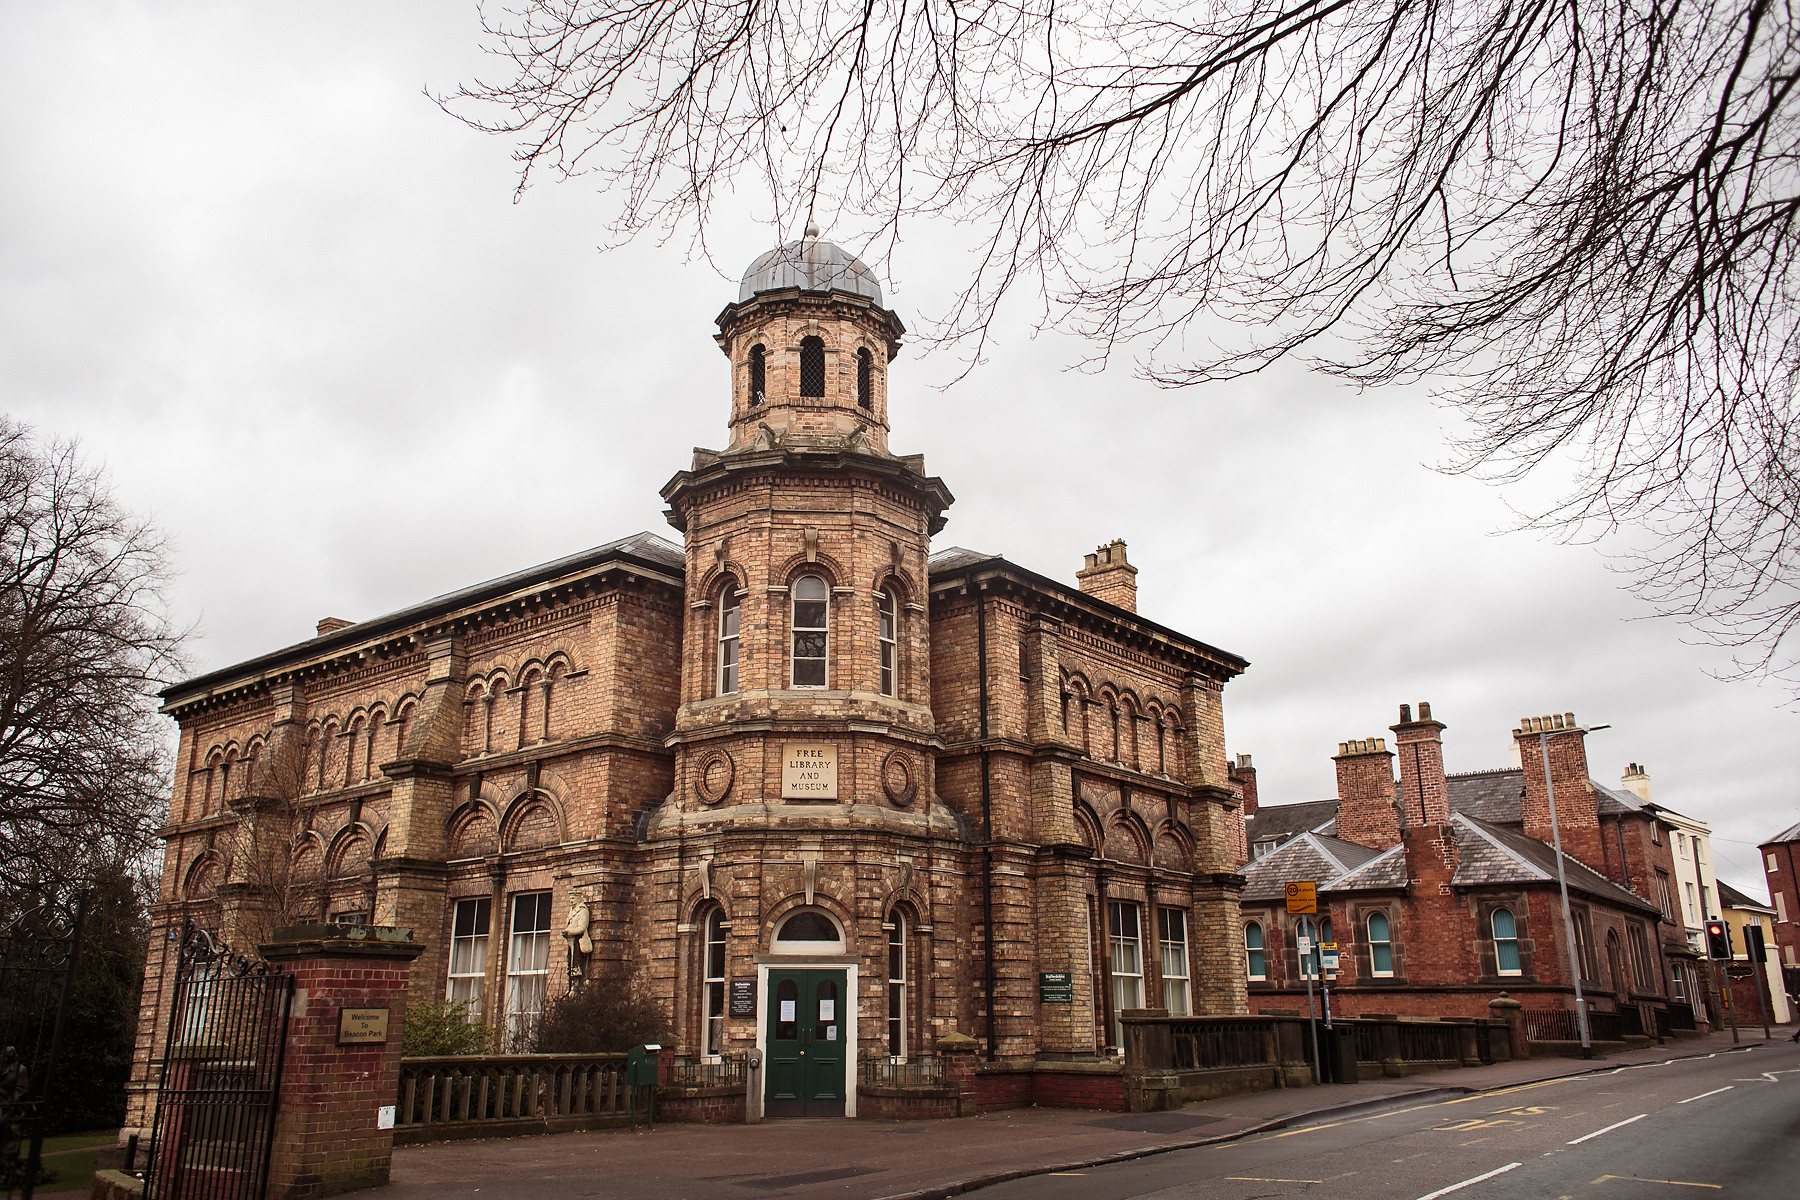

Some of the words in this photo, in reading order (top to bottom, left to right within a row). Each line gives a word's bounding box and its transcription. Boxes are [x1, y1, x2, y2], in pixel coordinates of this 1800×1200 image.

[796, 750, 824, 758] FREE
[790, 760, 831, 769] LIBRARY
[799, 772, 820, 780] AND
[791, 783, 829, 791] MUSEUM
[344, 1030, 368, 1038] Beacon
